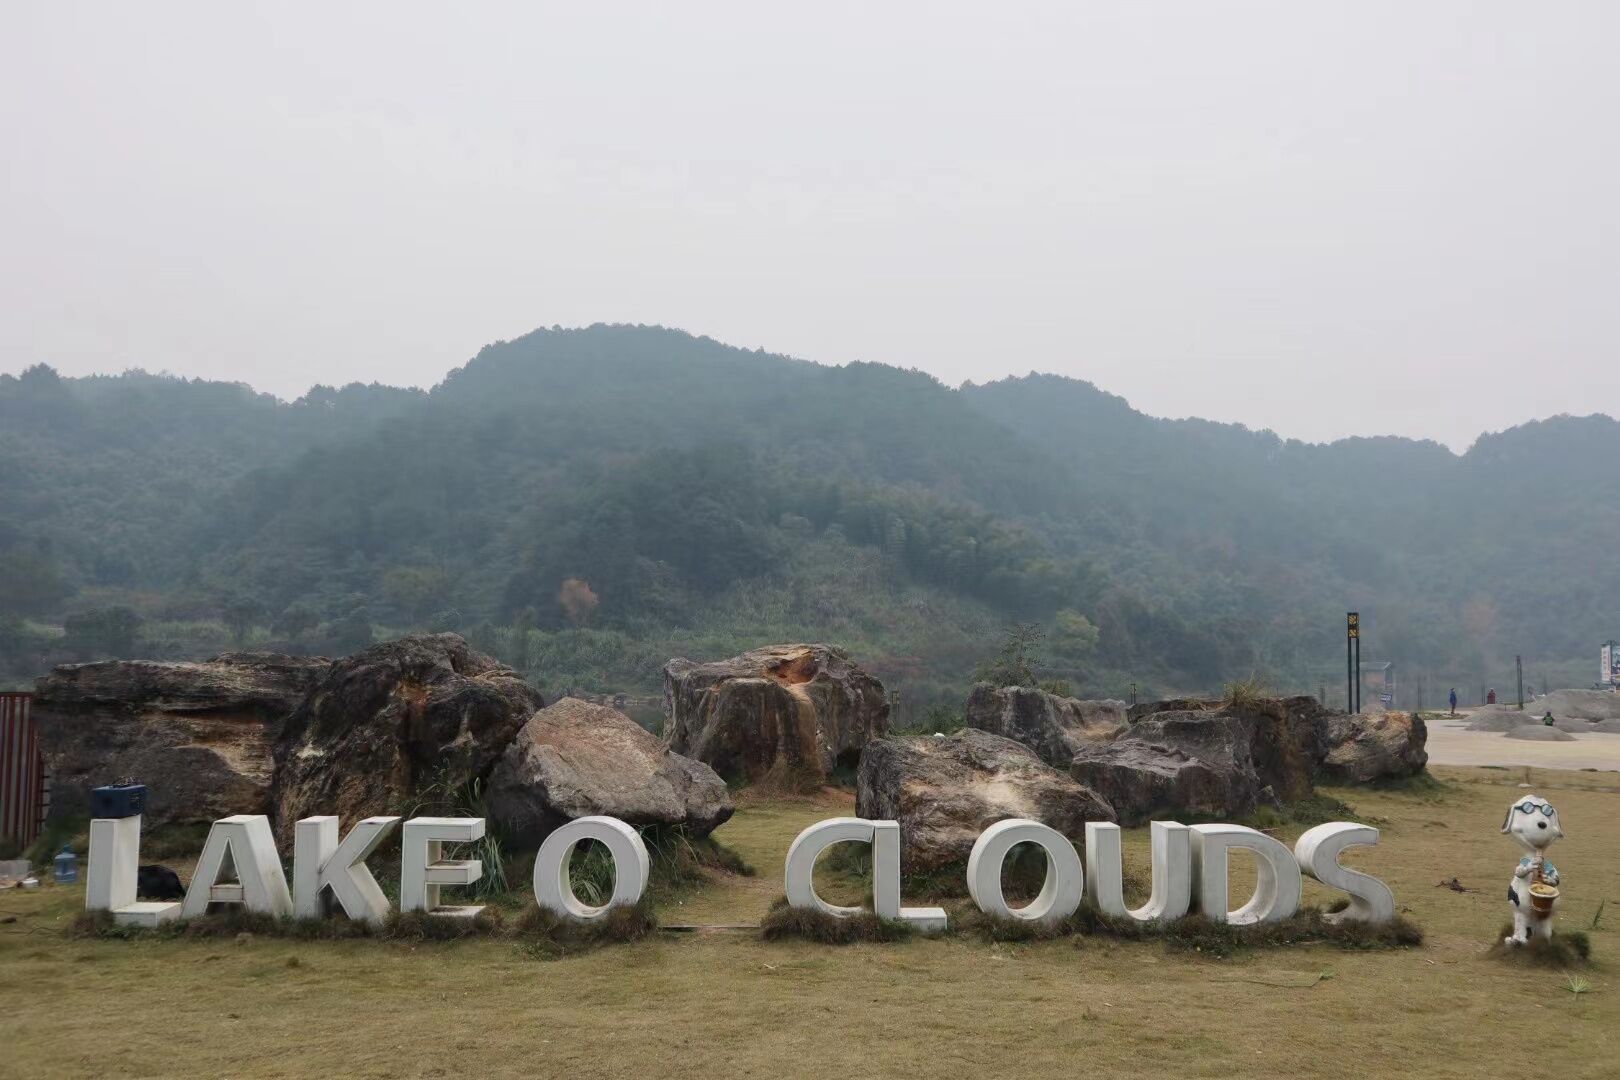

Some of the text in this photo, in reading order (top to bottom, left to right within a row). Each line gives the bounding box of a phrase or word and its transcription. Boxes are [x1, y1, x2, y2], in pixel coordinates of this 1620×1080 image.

[85, 815, 1395, 930] LAKE O CLOUDS
